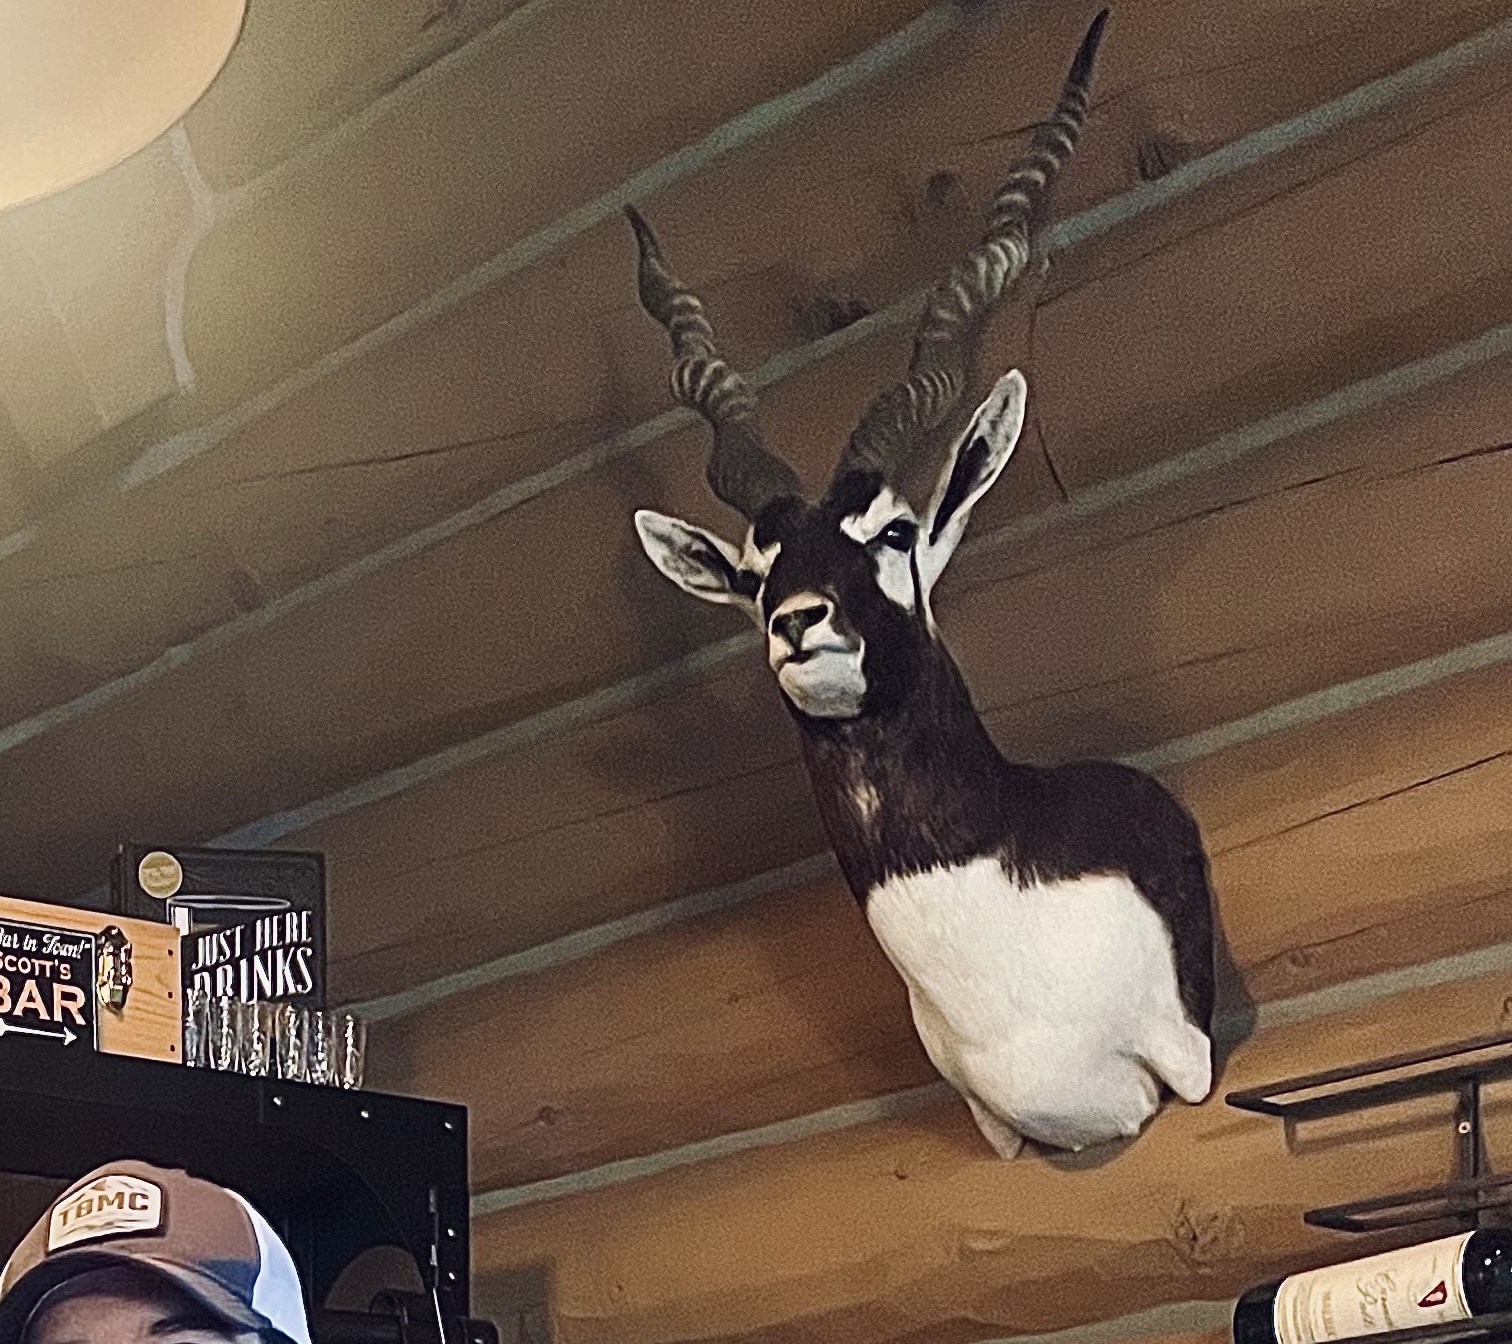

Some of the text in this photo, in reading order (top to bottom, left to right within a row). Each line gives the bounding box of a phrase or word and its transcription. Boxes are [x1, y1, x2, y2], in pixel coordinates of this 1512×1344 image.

[22, 936, 38, 952] in
[191, 910, 313, 971] JUST HERE
[58, 1191, 150, 1227] TBMC
